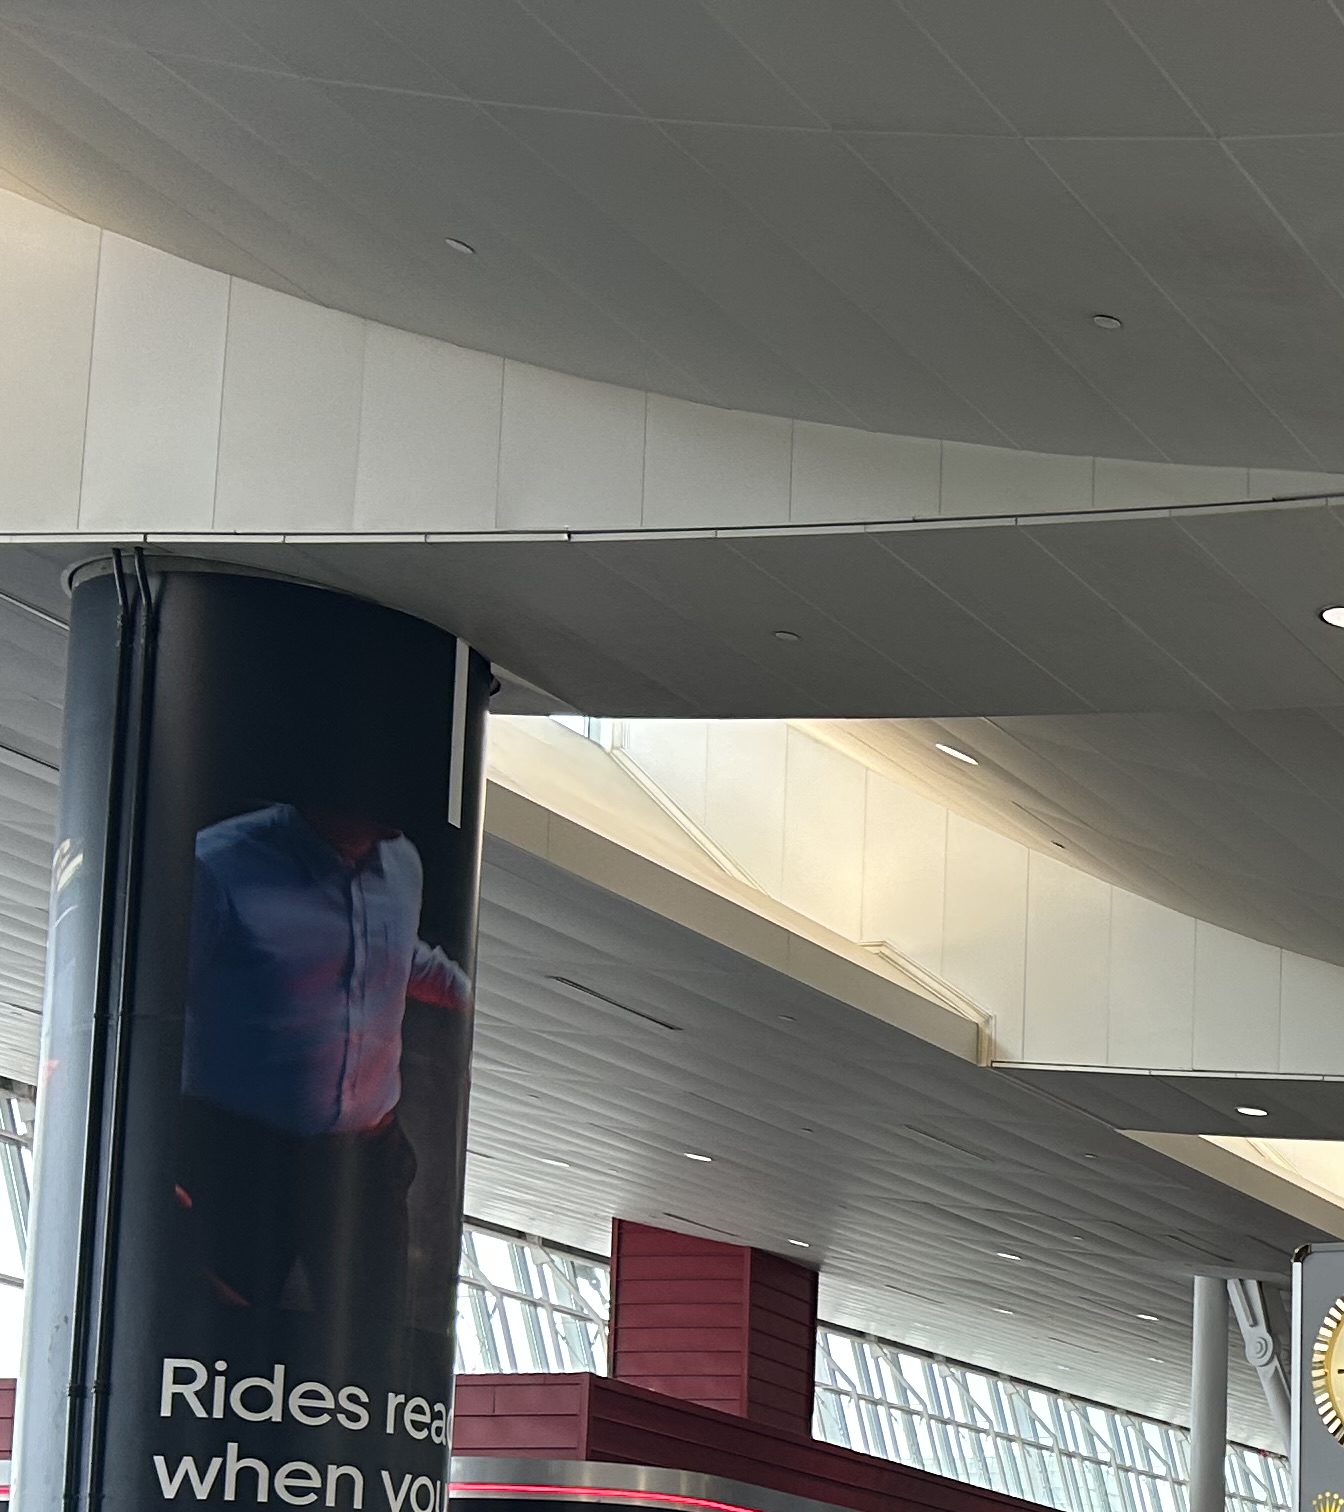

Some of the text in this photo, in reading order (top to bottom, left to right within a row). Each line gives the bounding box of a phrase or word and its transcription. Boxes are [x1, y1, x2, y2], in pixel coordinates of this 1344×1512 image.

[160, 1358, 452, 1450] Rides rea
[152, 1442, 364, 1510] when
